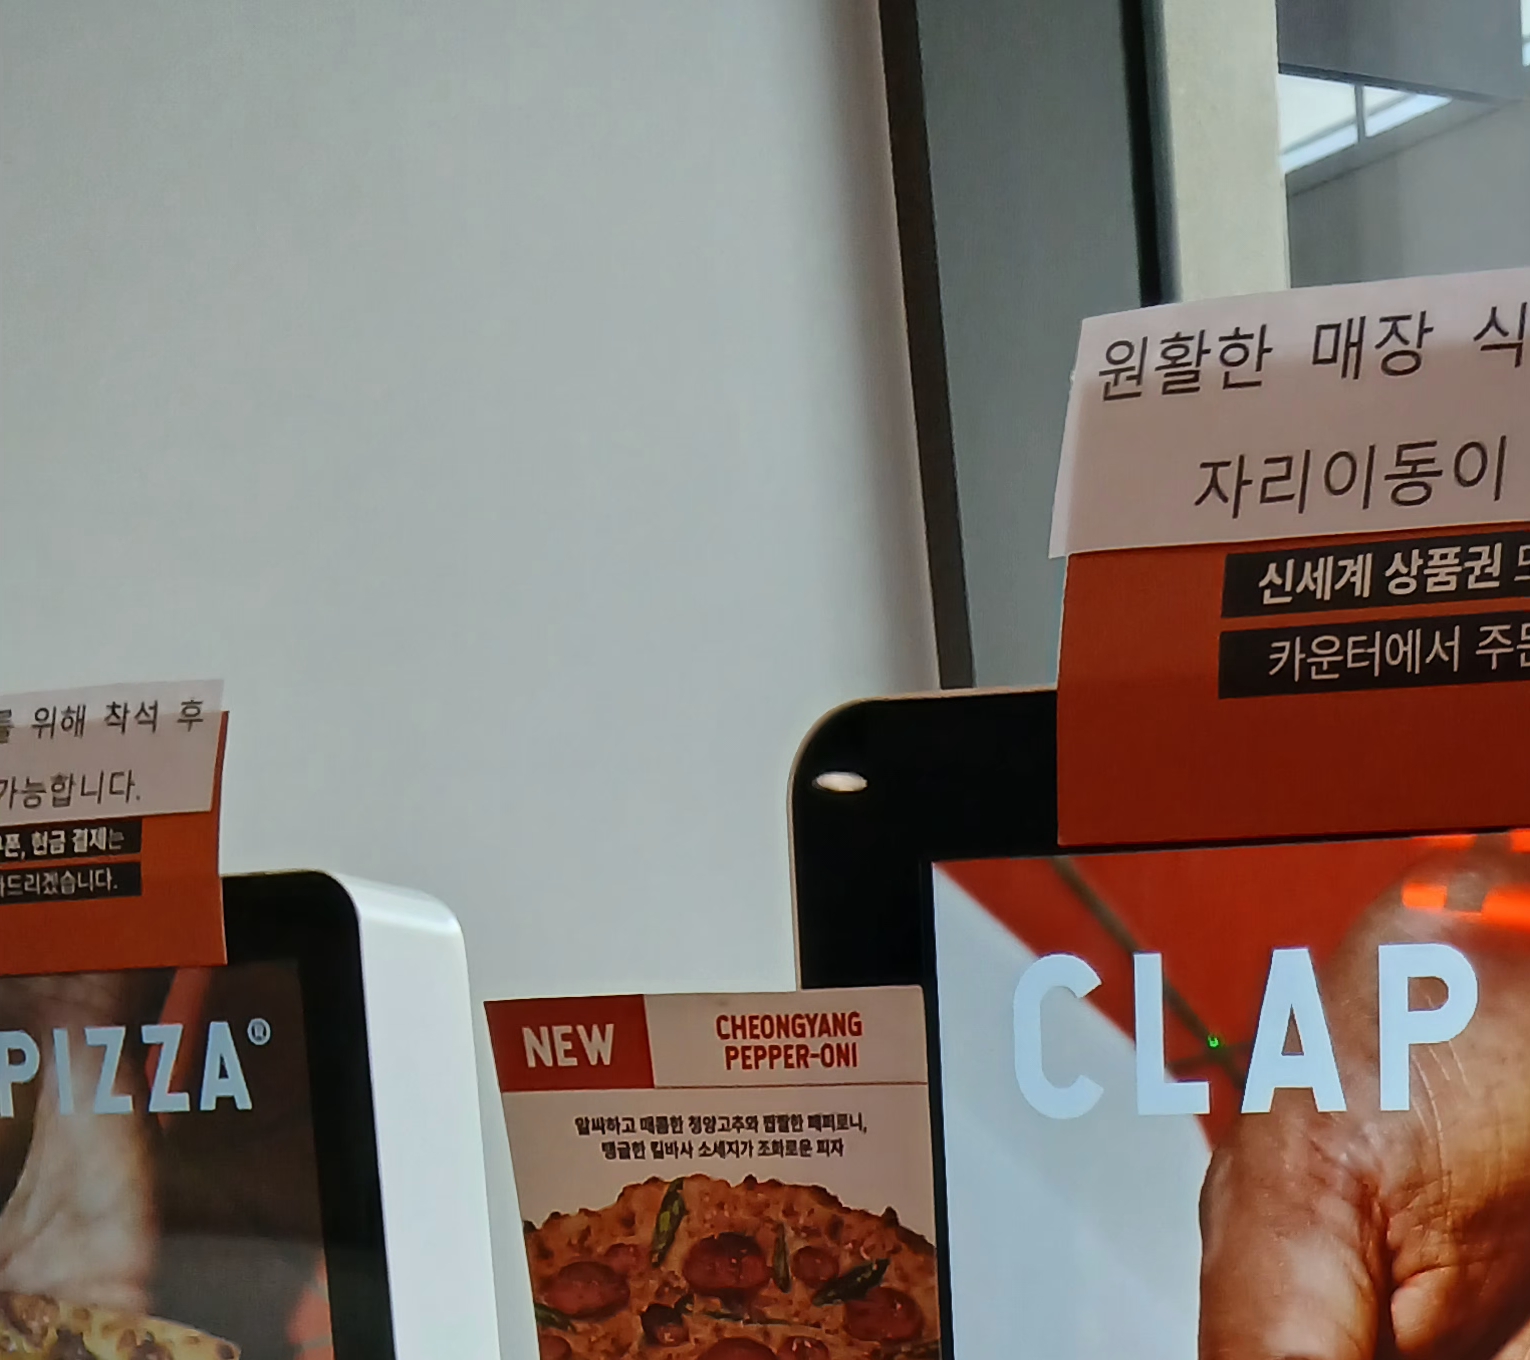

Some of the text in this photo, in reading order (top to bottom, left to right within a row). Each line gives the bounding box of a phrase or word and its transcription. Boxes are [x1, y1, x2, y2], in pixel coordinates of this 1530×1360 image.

[1098, 323, 1274, 402] 원활한
[1311, 310, 1434, 381] 매장
[1194, 434, 1507, 519] 자리이동이
[1258, 553, 1372, 606] 신세계
[1384, 541, 1503, 597] 상품권
[1267, 624, 1461, 684] 카운터에서
[31, 704, 87, 740] 위해
[104, 699, 159, 735] 착석
[177, 699, 204, 733] 후
[521, 1023, 615, 1069] NEW
[715, 1011, 863, 1040] CHEONGYANG
[1011, 940, 1479, 1121] CLAP
[724, 1041, 859, 1071] PEPPER-ONI
[816, 1137, 845, 1157] 피자
